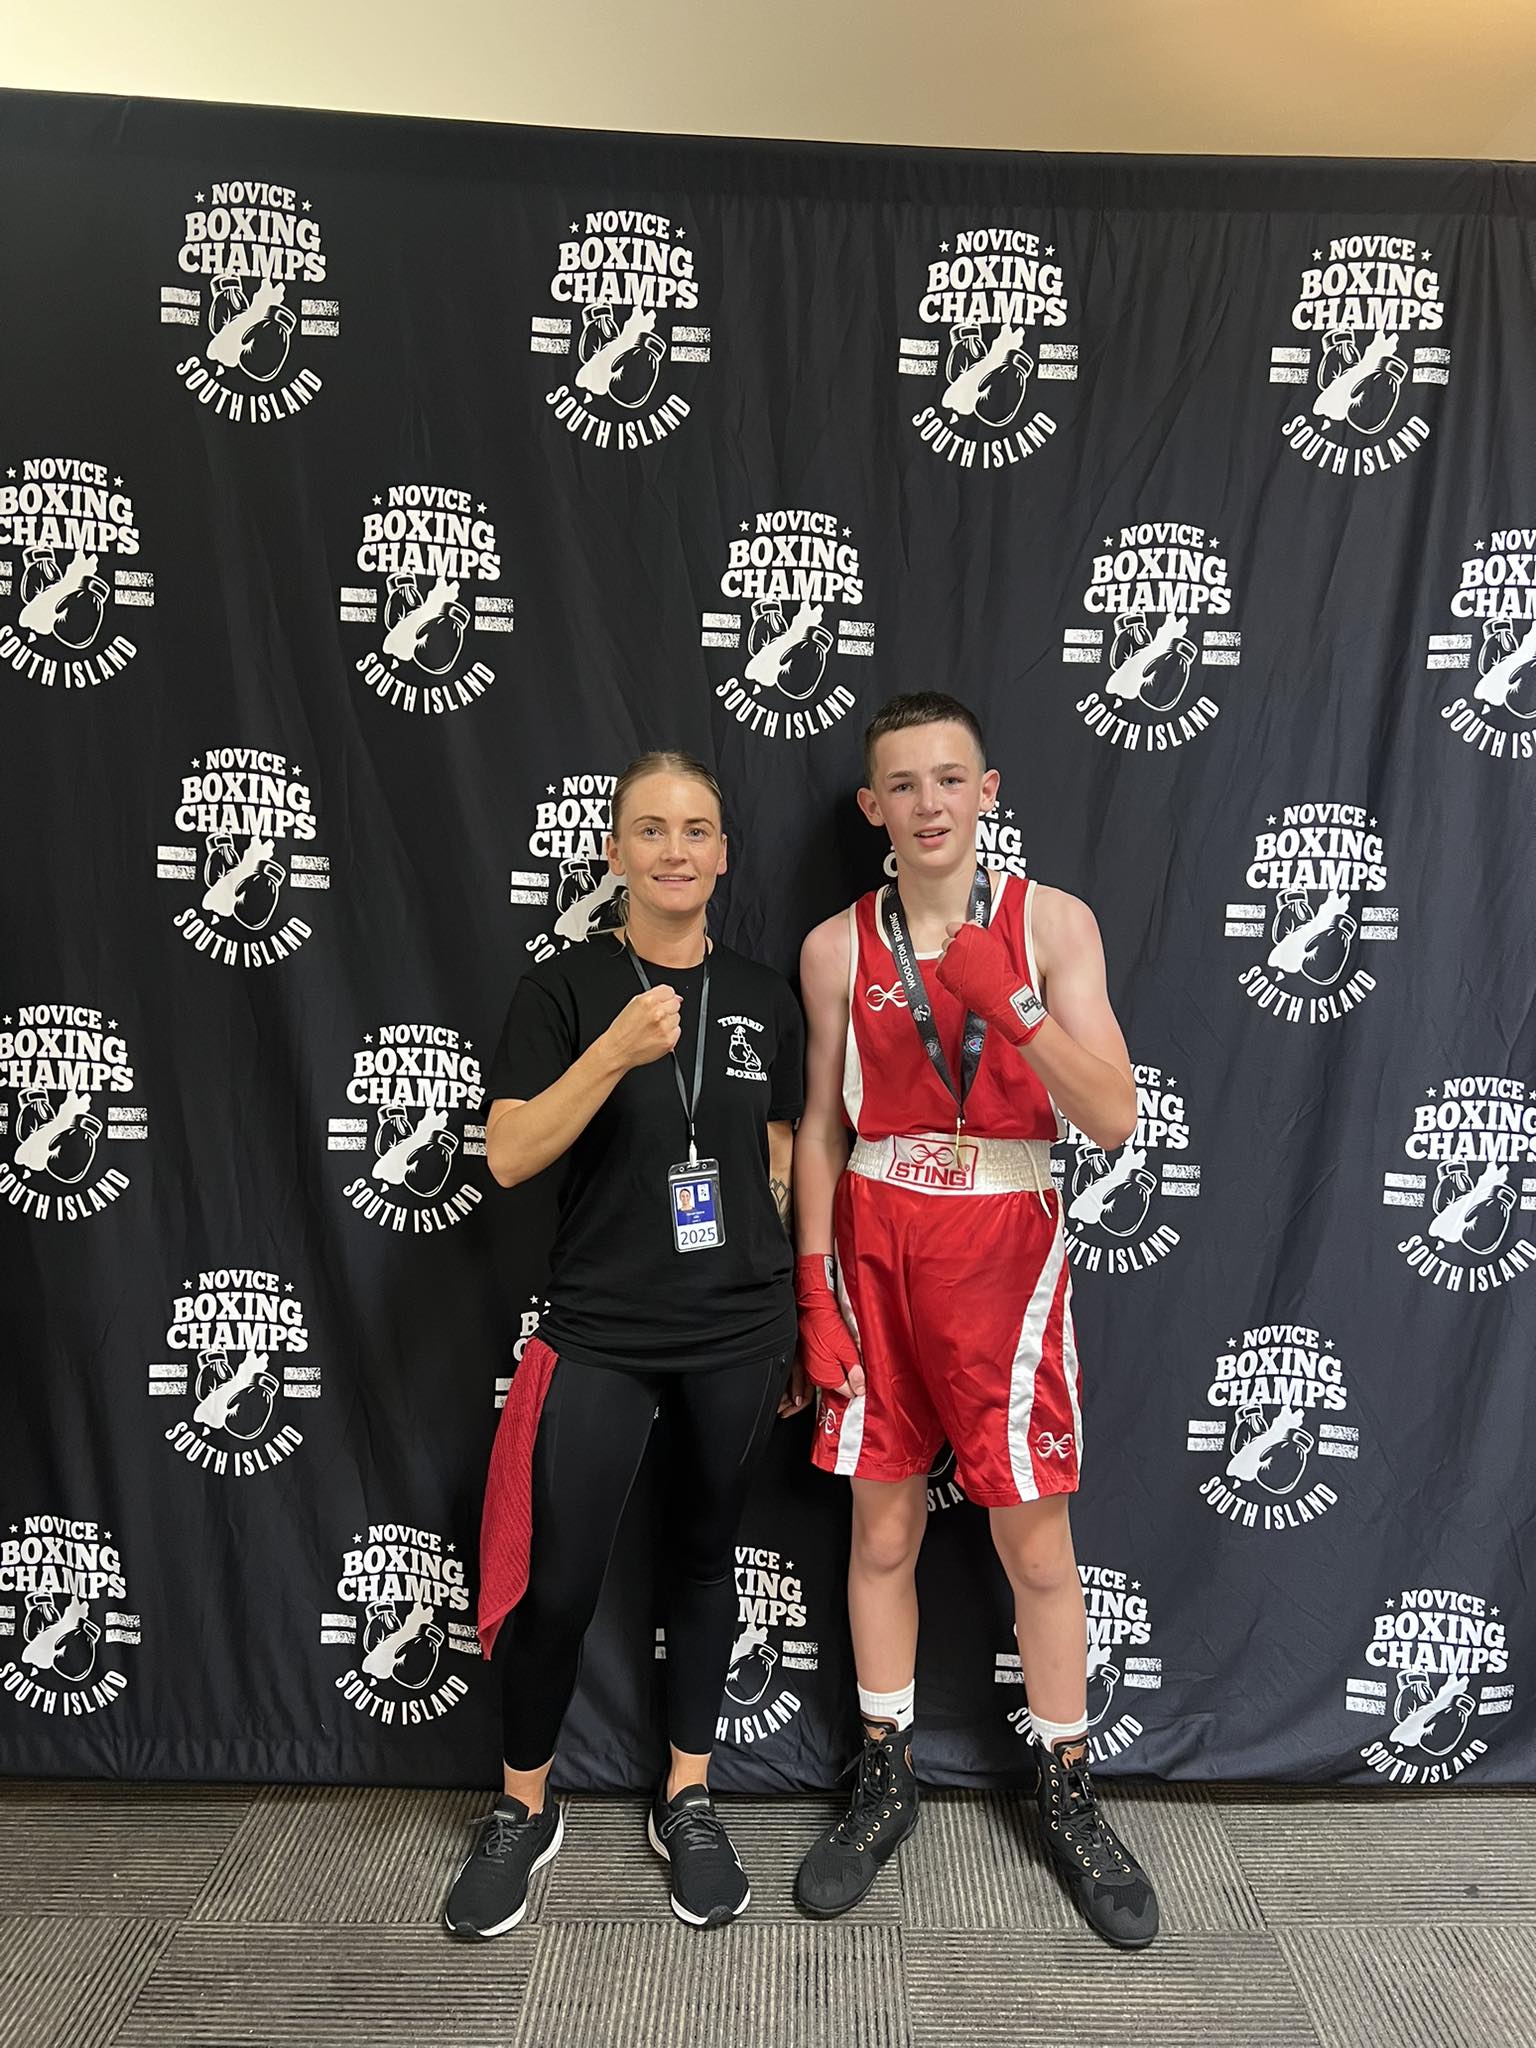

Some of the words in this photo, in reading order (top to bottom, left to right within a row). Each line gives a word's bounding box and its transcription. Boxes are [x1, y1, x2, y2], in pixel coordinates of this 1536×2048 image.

[212, 182, 295, 211] NOVICE
[186, 208, 321, 252] BOXING
[586, 211, 670, 239] NOVICE
[956, 229, 1039, 257] NOVICE
[178, 243, 326, 283] CHAMPS
[558, 237, 694, 279] BOXING
[1329, 236, 1416, 261] NOVICE
[551, 272, 698, 311] CHAMPS
[927, 255, 1063, 296] BOXING
[1300, 262, 1439, 300] BOXING
[919, 291, 1067, 328] CHAMPS
[1292, 297, 1444, 332] CHAMPS
[176, 357, 243, 421] SOUTH
[250, 369, 322, 422] ISLAND
[546, 386, 611, 448] SOUTH
[619, 395, 690, 450] ISLAND
[912, 407, 976, 467] SOUTH
[984, 412, 1056, 468] ISLAND
[1282, 415, 1348, 474] SOUTH
[1354, 416, 1430, 476] ISLAND
[23, 458, 107, 487] NOVICE
[0, 483, 133, 526] BOXING
[389, 485, 471, 513] NOVICE
[363, 510, 495, 552] BOXING
[756, 510, 837, 537] NOVICE
[1120, 523, 1204, 548] NOVICE
[1490, 530, 1536, 552] NOV
[357, 543, 500, 582] CHAMPS
[728, 535, 859, 576] BOXING
[1091, 548, 1227, 586] BOXING
[1460, 554, 1536, 589] BOX
[721, 569, 863, 606] CHAMPS
[1084, 581, 1231, 616] CHAMPS
[1451, 588, 1536, 624] CHA
[65, 636, 136, 688] ISLAND
[356, 653, 417, 712] SOUTH
[424, 662, 495, 714] ISLAND
[716, 678, 779, 737] SOUTH
[786, 686, 855, 739] ISLAND
[1076, 693, 1141, 750] SOUTH
[1147, 697, 1219, 751] ISLAND
[1441, 698, 1506, 757] SOUTH
[206, 748, 286, 775] NOVICE
[182, 772, 311, 813] BOXING
[562, 775, 618, 796] NOVI
[175, 804, 316, 841] CHAMPS
[536, 799, 613, 830] BOX
[1283, 804, 1366, 827] NOVICE
[529, 830, 612, 861] CHA
[1254, 827, 1383, 864] BOXING
[1246, 860, 1387, 893] CHAMPS
[889, 912, 904, 943] BOXING
[975, 900, 985, 925] OXING
[174, 909, 237, 965] SOUTH
[244, 918, 312, 967] ISLAND
[897, 943, 917, 990] WOOLSTON
[1238, 966, 1303, 1022] SOUTH
[1310, 970, 1376, 1023] ISLAND
[19, 1005, 101, 1030] NOVICE
[717, 1015, 765, 1033] TIMARU
[380, 1025, 458, 1049] NOVICE
[354, 1047, 481, 1084] BOXING
[347, 1077, 485, 1112] CHAMPS
[1443, 1077, 1524, 1101] NOVICE
[895, 1161, 966, 1186] STING
[57, 1169, 129, 1221] ISLAND
[343, 1178, 407, 1231] SOUTH
[414, 1184, 482, 1233] ISLAND
[680, 1227, 716, 1245] 2025
[1064, 1227, 1102, 1272] UTH
[1109, 1225, 1180, 1273] ISLAND
[199, 1270, 279, 1292] NOVICE
[1398, 1235, 1463, 1291] SOUTH
[1470, 1239, 1536, 1292] ISLAND
[173, 1292, 303, 1326] BOXING
[167, 1322, 308, 1353] CHAMPS
[1243, 1325, 1319, 1349] NOVICE
[1215, 1347, 1342, 1384] BOXING
[1208, 1377, 1347, 1411] CHAMPS
[165, 1422, 227, 1474] SOUTH
[235, 1426, 303, 1476] ISLAND
[1199, 1476, 1258, 1527] SOUTH
[1265, 1483, 1337, 1529] ISLAND
[25, 1515, 98, 1540] NOVICE
[368, 1524, 441, 1546] NOVICE
[1, 1537, 120, 1574] BOXING
[343, 1545, 462, 1577] BOXING
[735, 1546, 780, 1570] VICE
[0, 1566, 126, 1600] CHAMPS
[337, 1574, 468, 1606] CHAMPS
[734, 1567, 802, 1603] ING
[1077, 1565, 1126, 1590] VICE
[738, 1596, 807, 1627] MPS
[1082, 1587, 1148, 1621] ING
[1401, 1589, 1485, 1617] NOVICE
[1087, 1617, 1151, 1645] MPS
[1373, 1611, 1505, 1649] BOXING
[1365, 1641, 1508, 1679] CHAMPS
[0, 1662, 57, 1714] SOUTH
[64, 1671, 127, 1715] ISLAND
[336, 1670, 395, 1724] SOUTH
[402, 1676, 468, 1725] ISLAND
[735, 1691, 801, 1743] ISLAND
[1088, 1714, 1144, 1764] LAND
[1360, 1741, 1418, 1784] SOUTH
[1420, 1739, 1488, 1785] ISLAND
